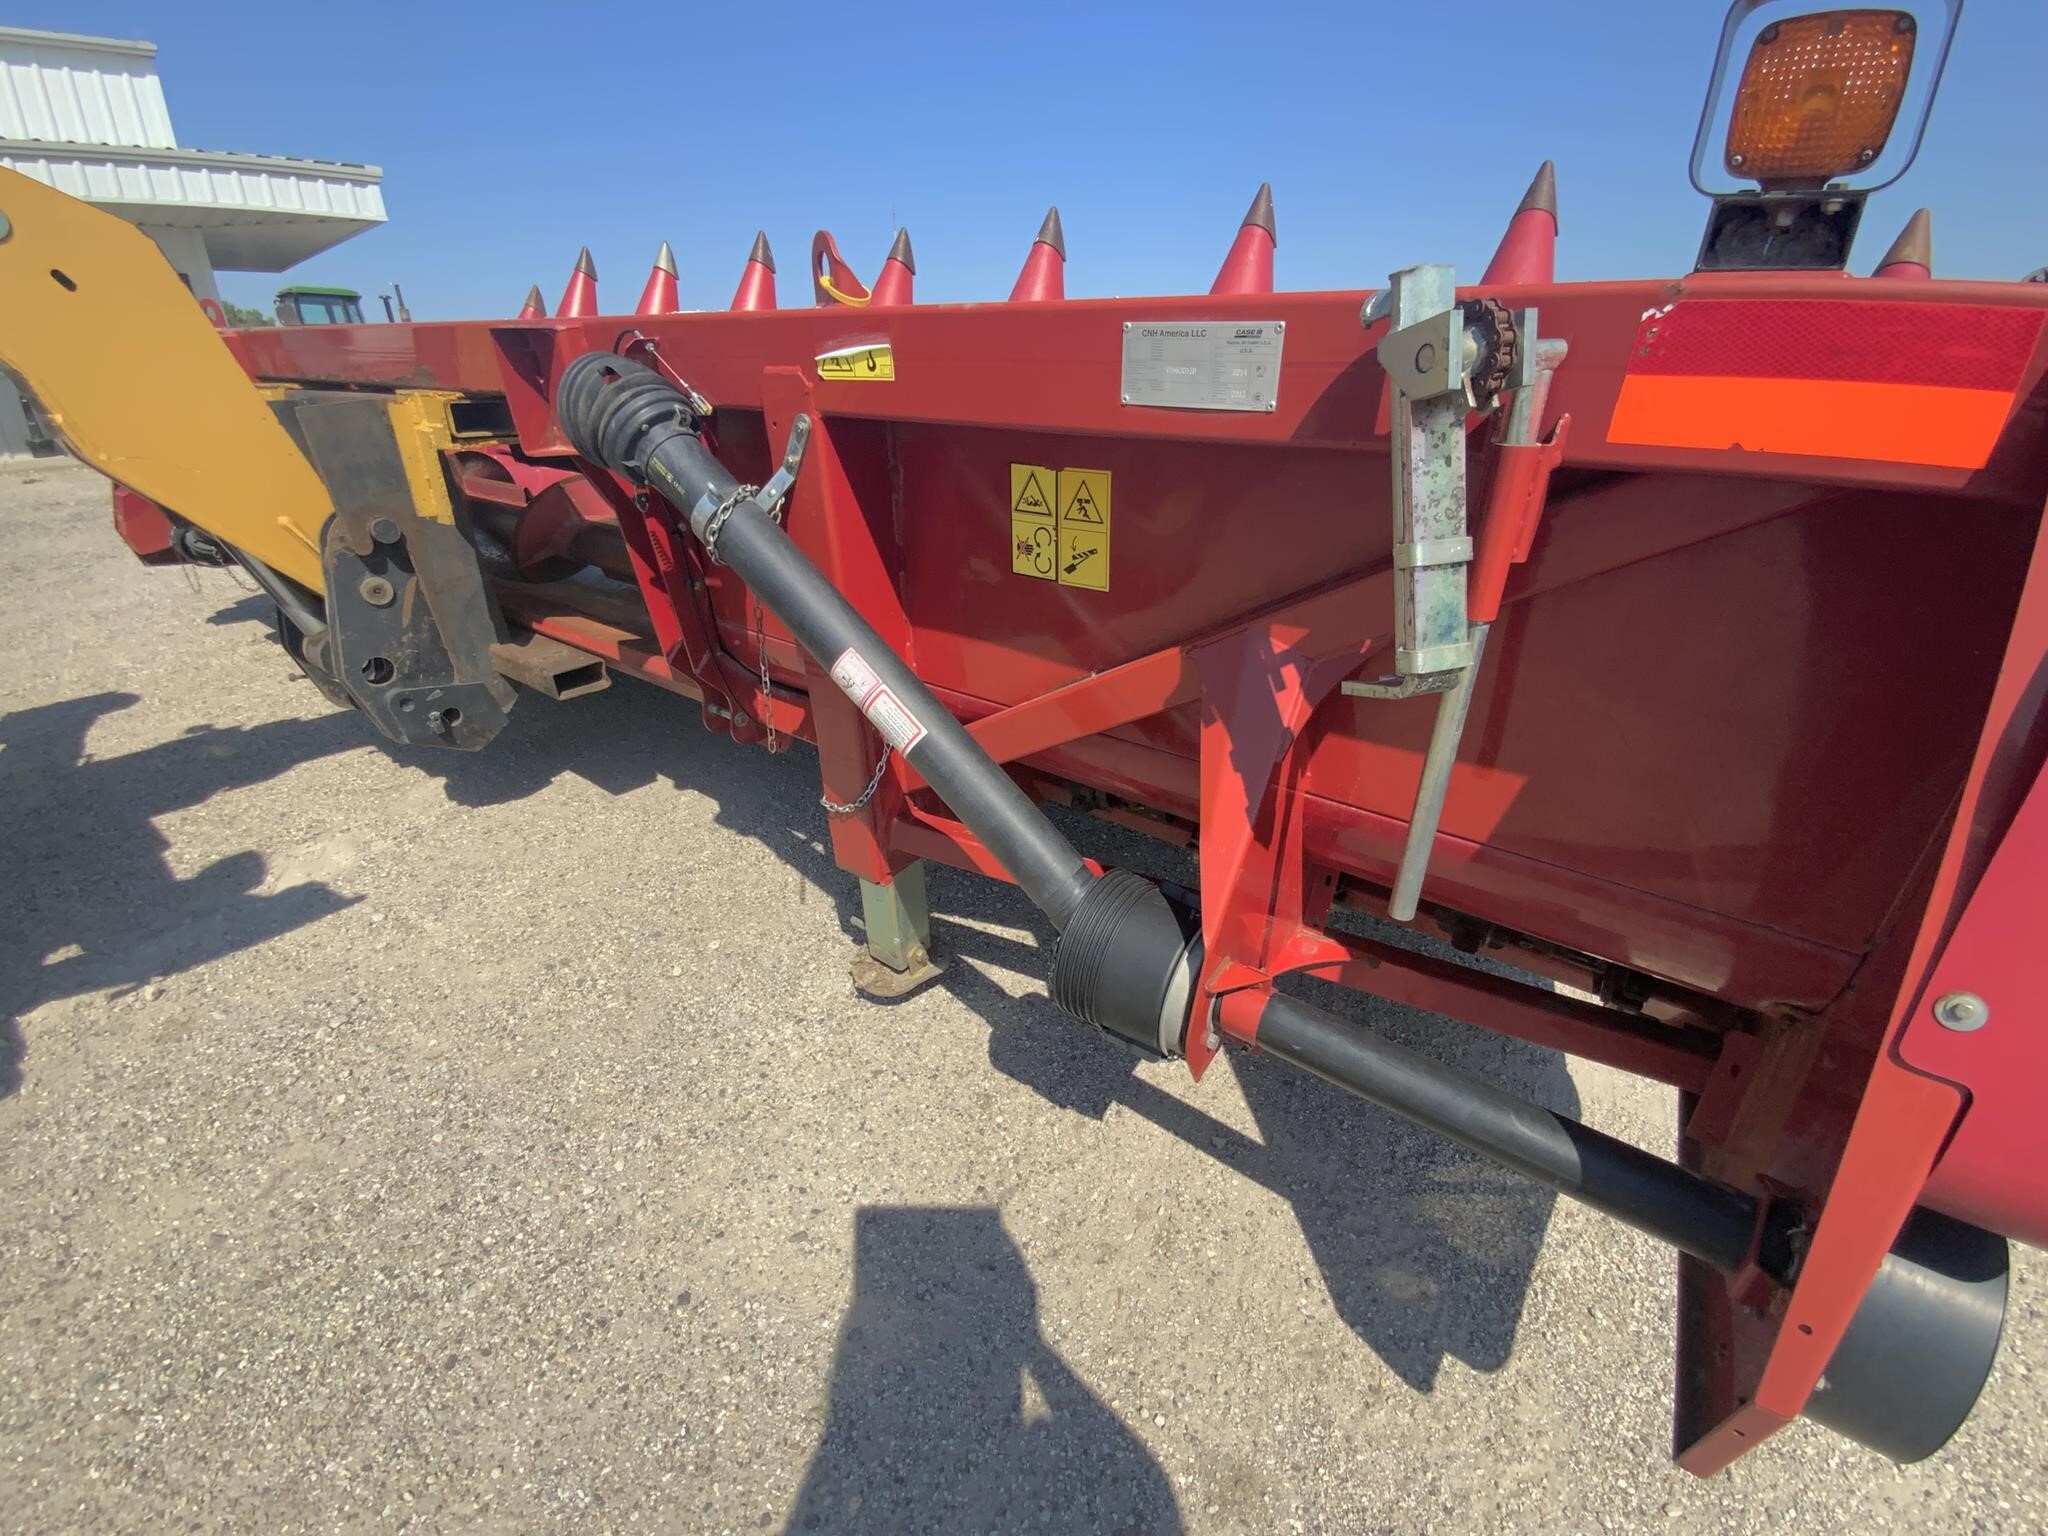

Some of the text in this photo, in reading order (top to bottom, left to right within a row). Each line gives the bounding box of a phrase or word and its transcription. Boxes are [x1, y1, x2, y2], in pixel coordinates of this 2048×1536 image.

[1142, 329, 1207, 338] CNH America LLC
